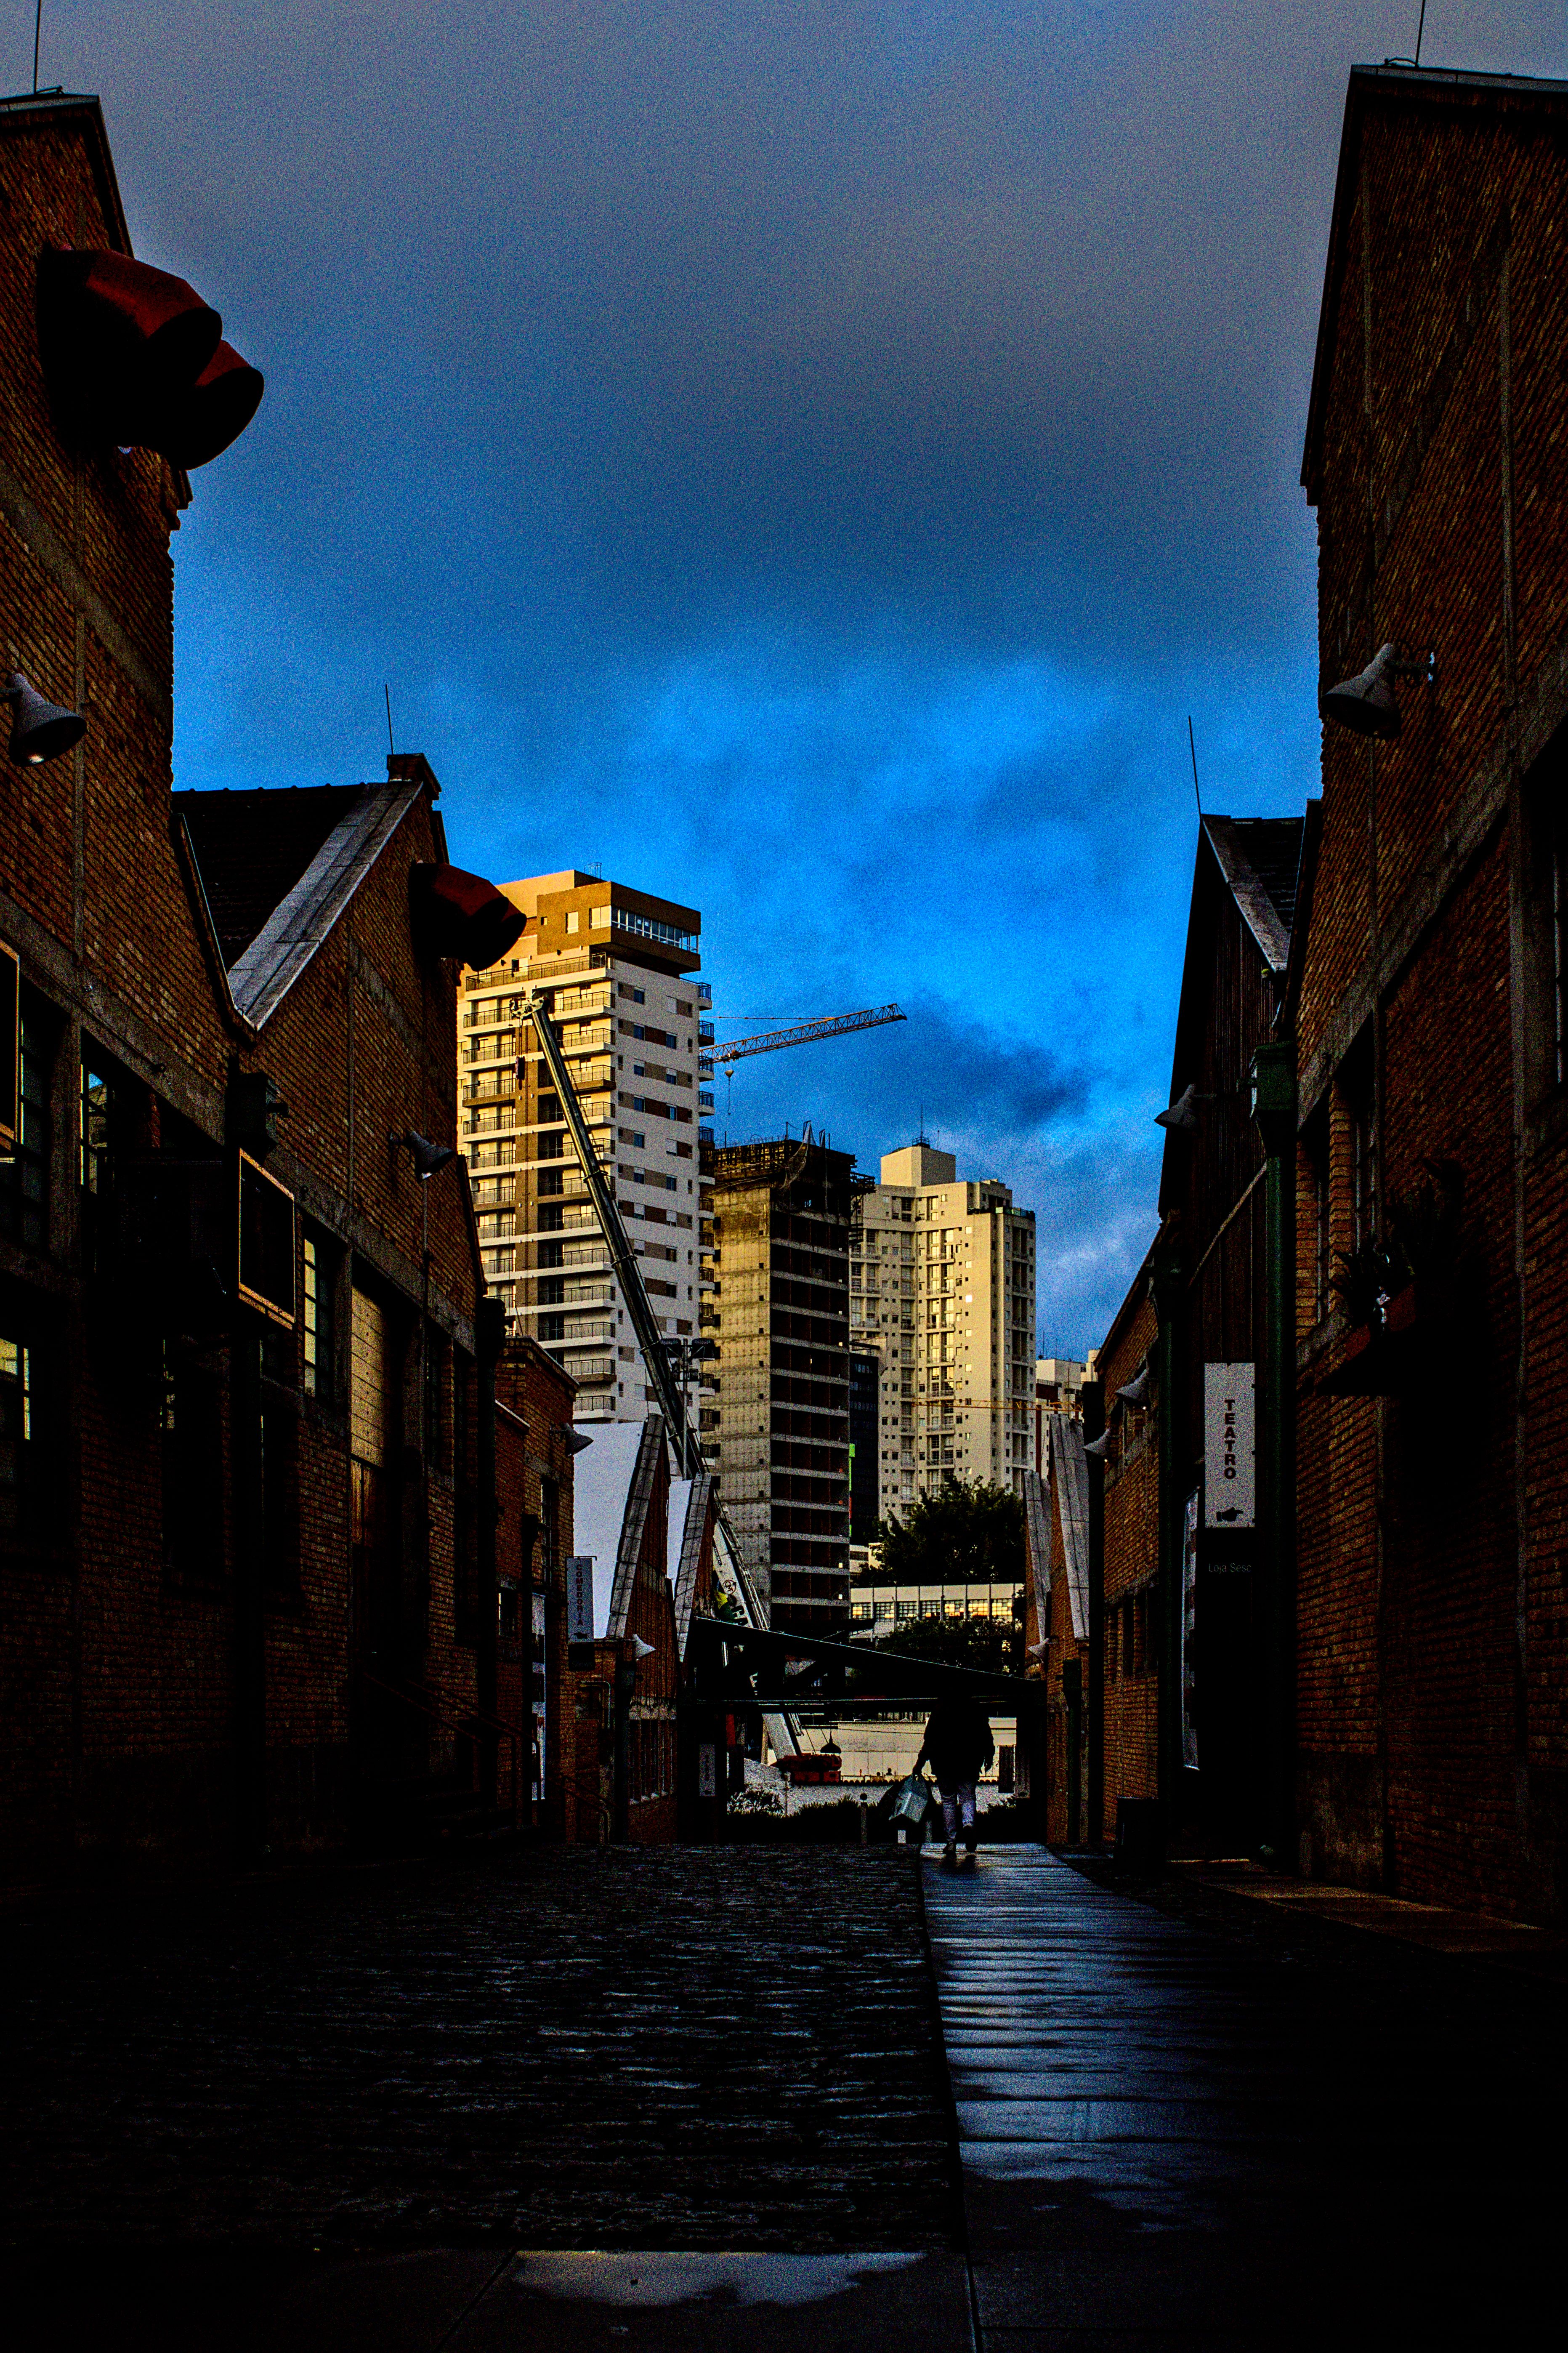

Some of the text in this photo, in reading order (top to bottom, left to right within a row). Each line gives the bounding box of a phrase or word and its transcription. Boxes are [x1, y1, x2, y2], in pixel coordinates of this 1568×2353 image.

[1224, 1399, 1236, 1480] TEATRO
[1208, 1562, 1252, 1574] Loja Sesc
